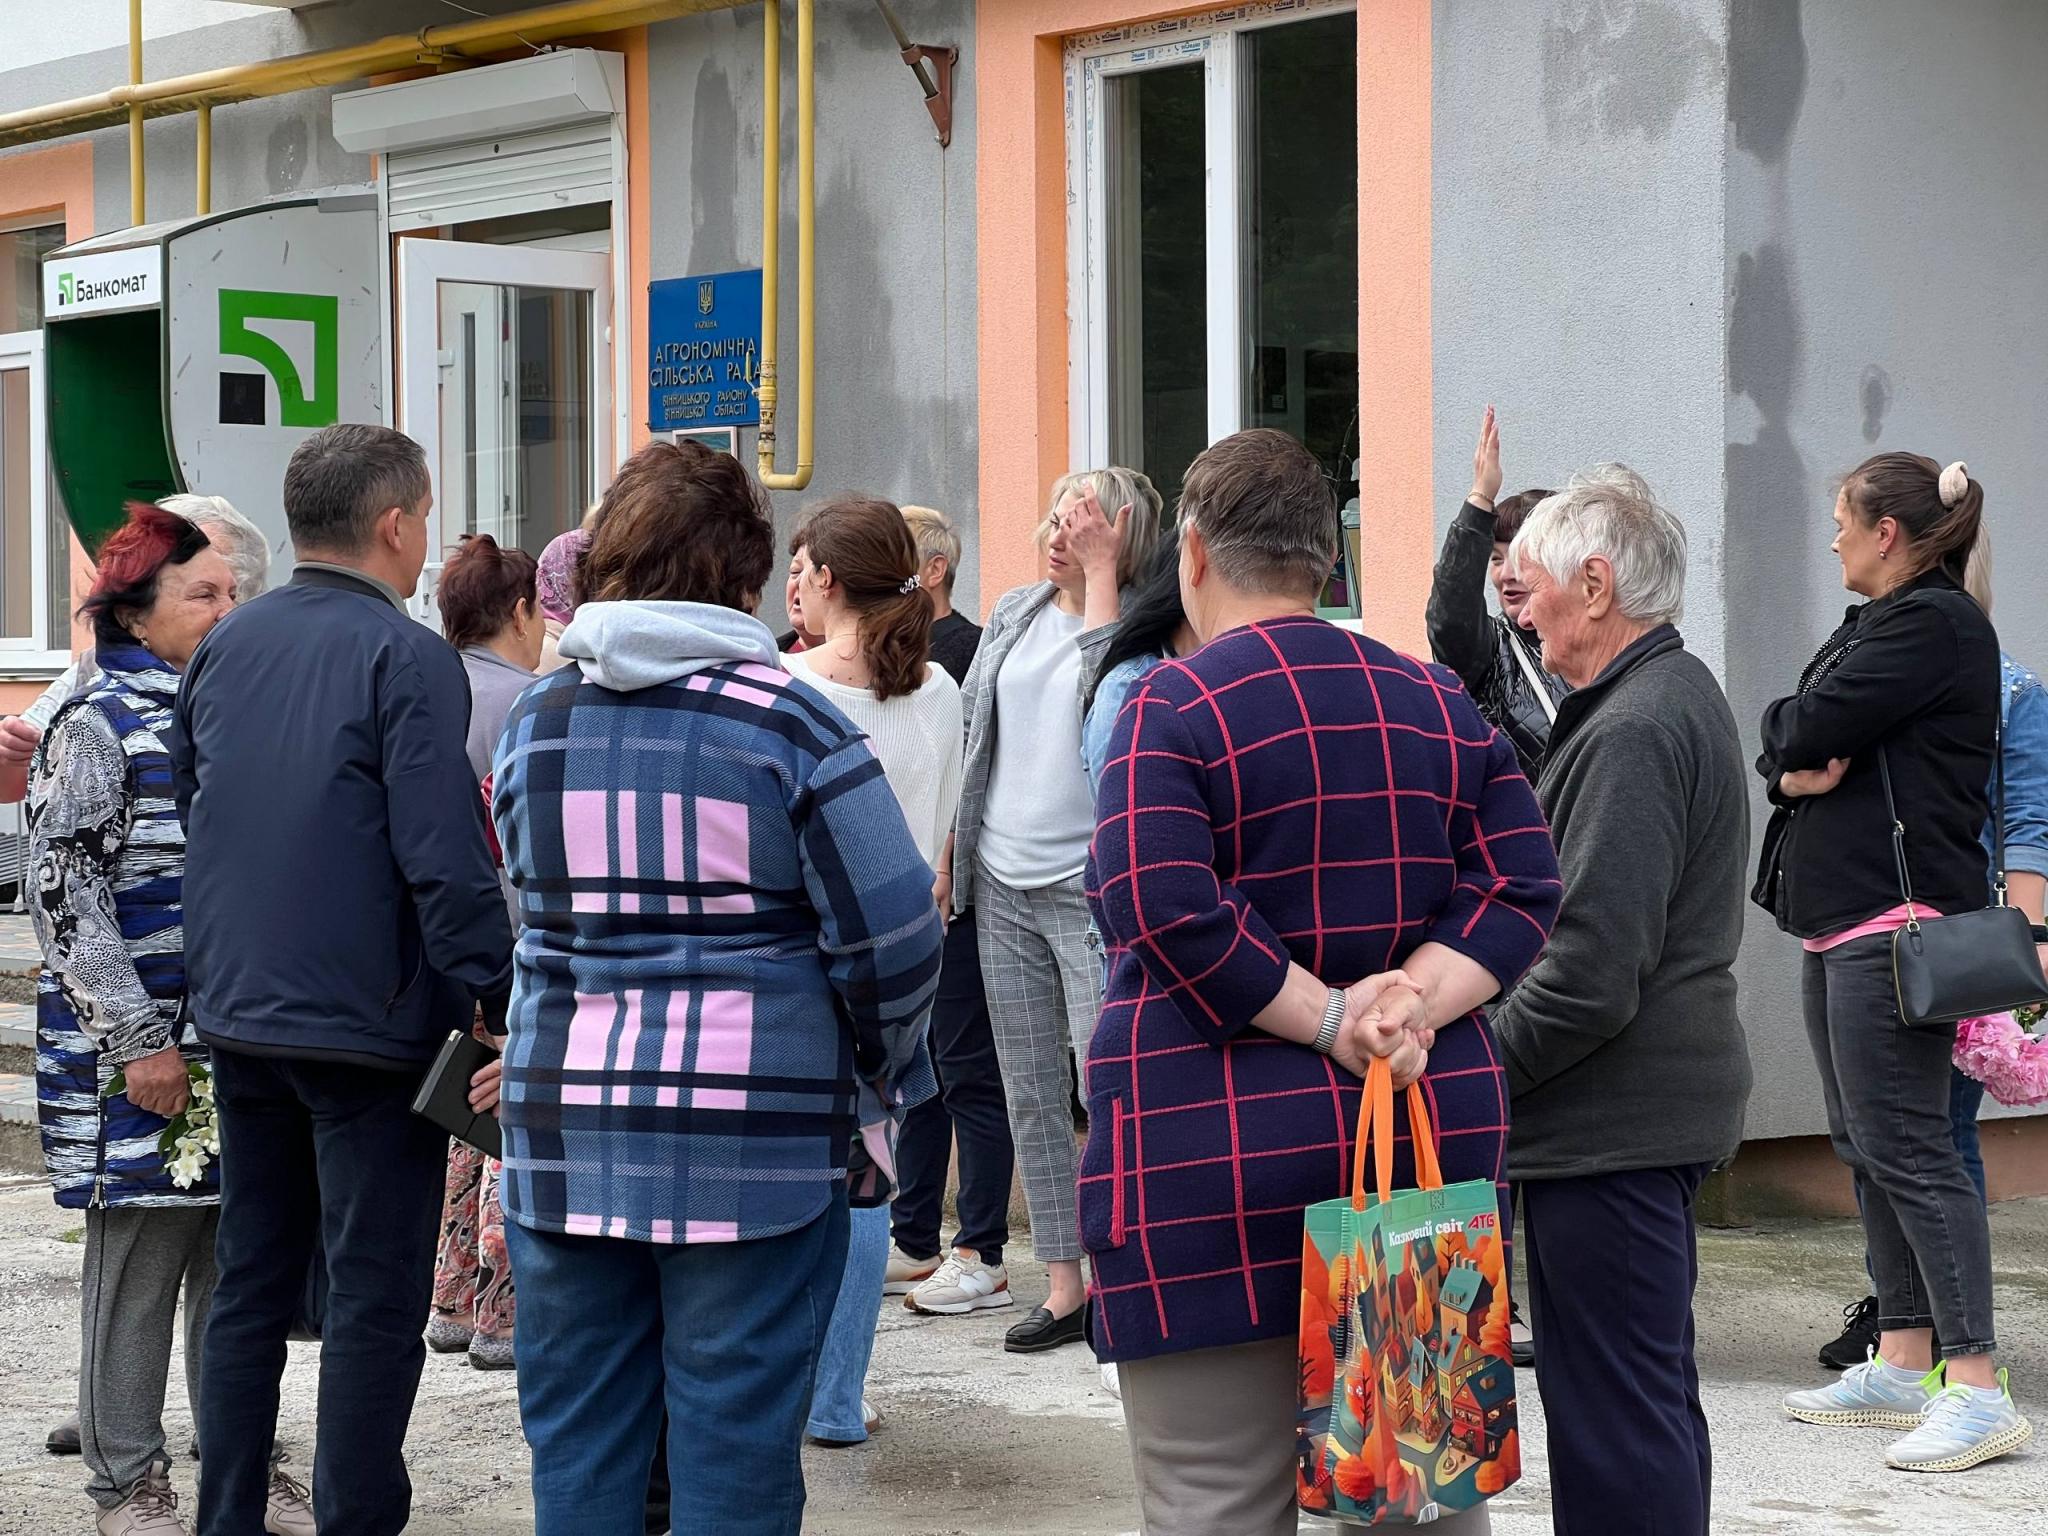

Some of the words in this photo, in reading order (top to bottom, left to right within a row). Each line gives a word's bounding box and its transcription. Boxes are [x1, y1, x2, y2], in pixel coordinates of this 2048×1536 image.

[76, 274, 147, 302] Банкомат
[655, 337, 756, 363] АГРОНОМІЧНА
[650, 364, 714, 387] СІЛЬСЬКА
[717, 389, 748, 402] РАЙОНУ
[714, 402, 747, 416] ОБЛАСТІ
[1388, 1220, 1433, 1247] Казковий
[1435, 1218, 1464, 1233] світ
